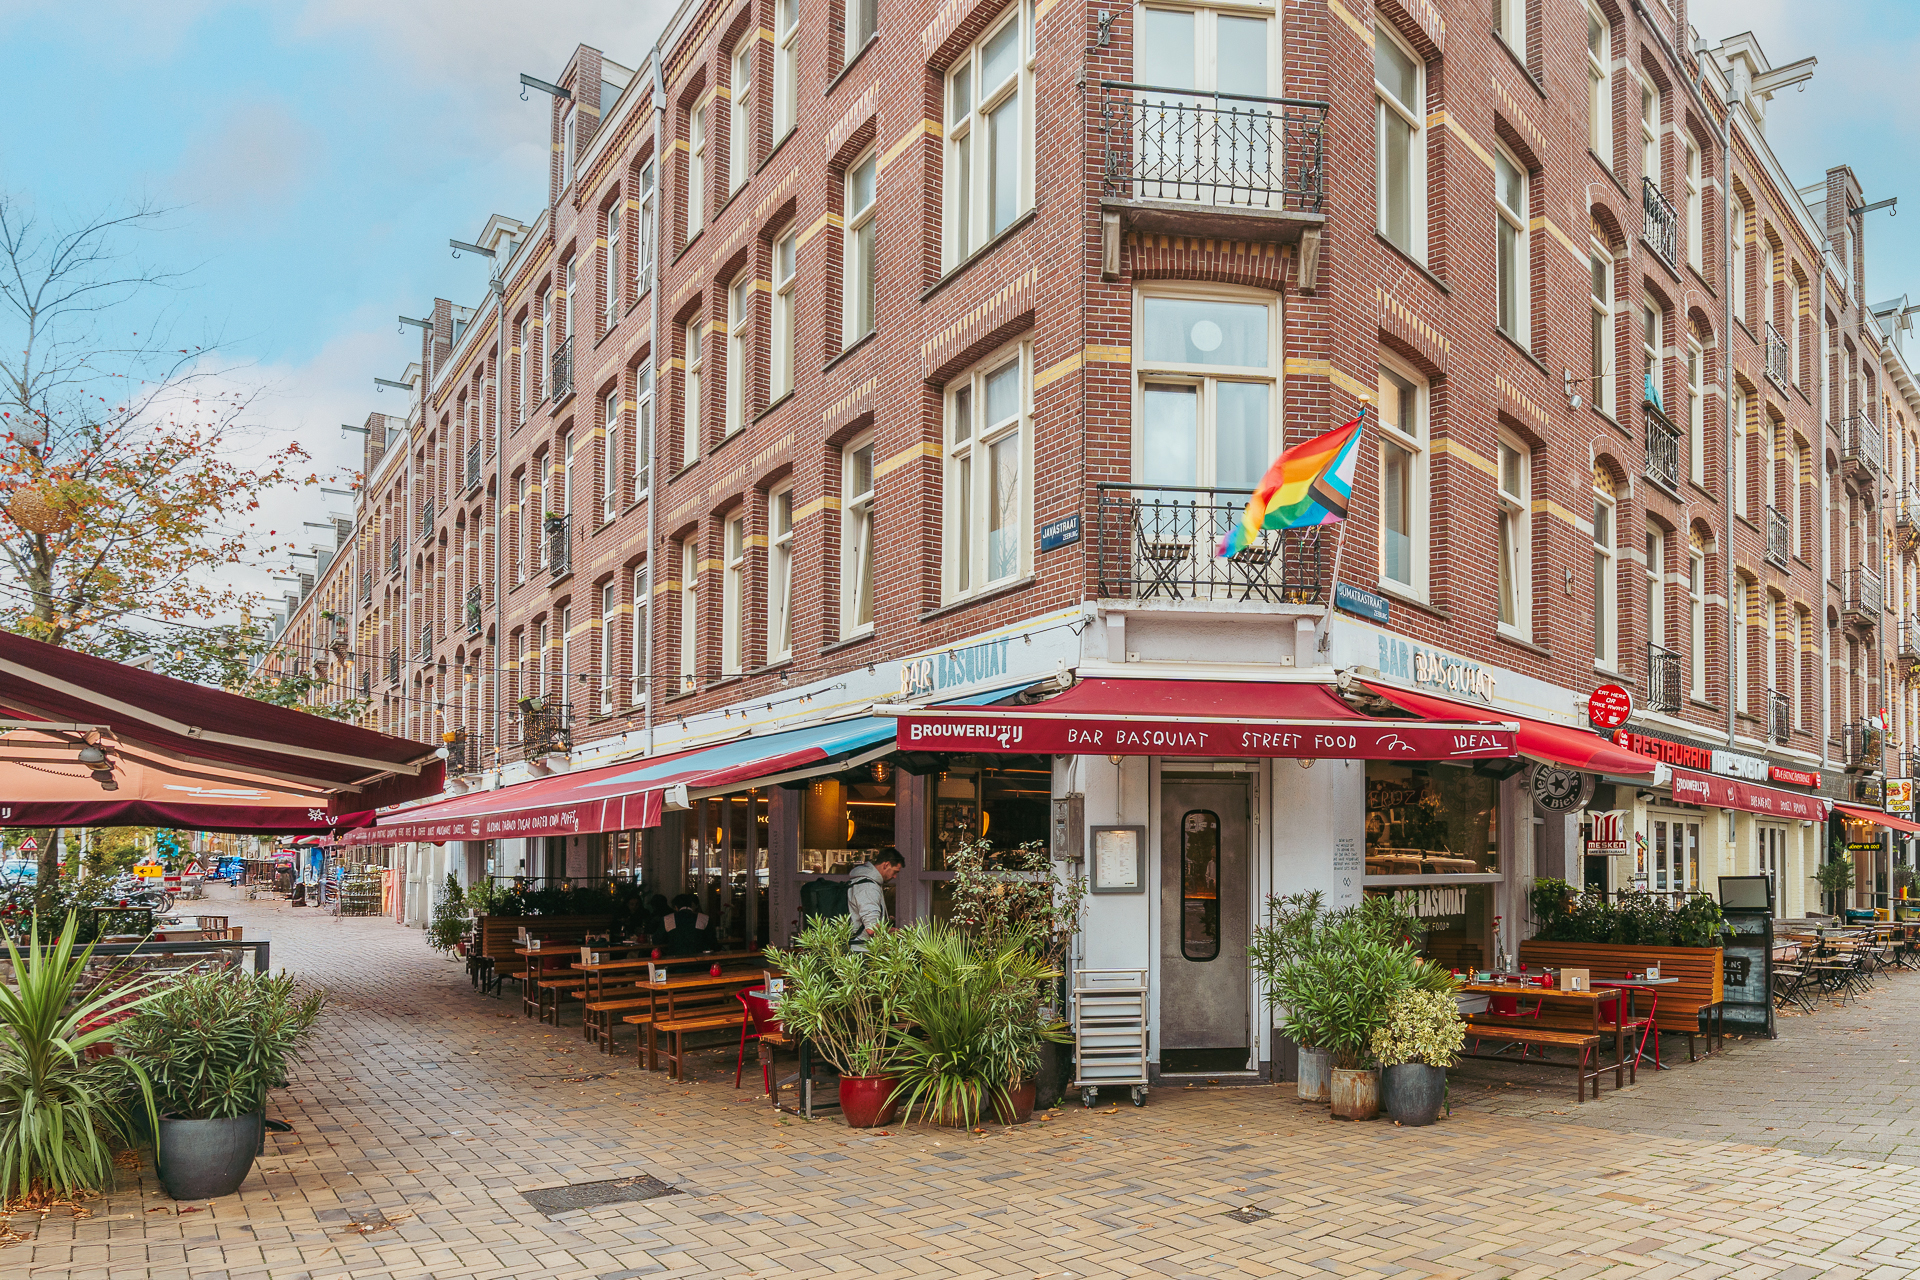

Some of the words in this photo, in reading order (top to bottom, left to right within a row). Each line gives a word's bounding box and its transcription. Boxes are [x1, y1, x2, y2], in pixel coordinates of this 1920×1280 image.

[1043, 517, 1077, 539] JAVASTRAAT
[901, 657, 934, 695] BAR
[939, 636, 1009, 689] BASQUIAT
[1378, 635, 1409, 680] BAR
[1413, 648, 1497, 702] BASQUIAT
[1605, 697, 1617, 705] OR
[1611, 692, 1627, 700] HERE
[1591, 700, 1606, 709] TAKE
[1607, 704, 1628, 712] AWAY?
[911, 724, 997, 740] BROUWERIJ
[1068, 729, 1103, 746] BAR
[1116, 730, 1208, 748] BASQUIAT
[1241, 731, 1302, 748] STREET
[1315, 734, 1357, 749] FOOD
[1453, 734, 1501, 748] IDEAL
[1634, 735, 1713, 770] RESTAURANT
[1550, 794, 1576, 808] Bier
[1588, 841, 1626, 849] MESKEN
[1418, 888, 1467, 917] BASQUIAT
